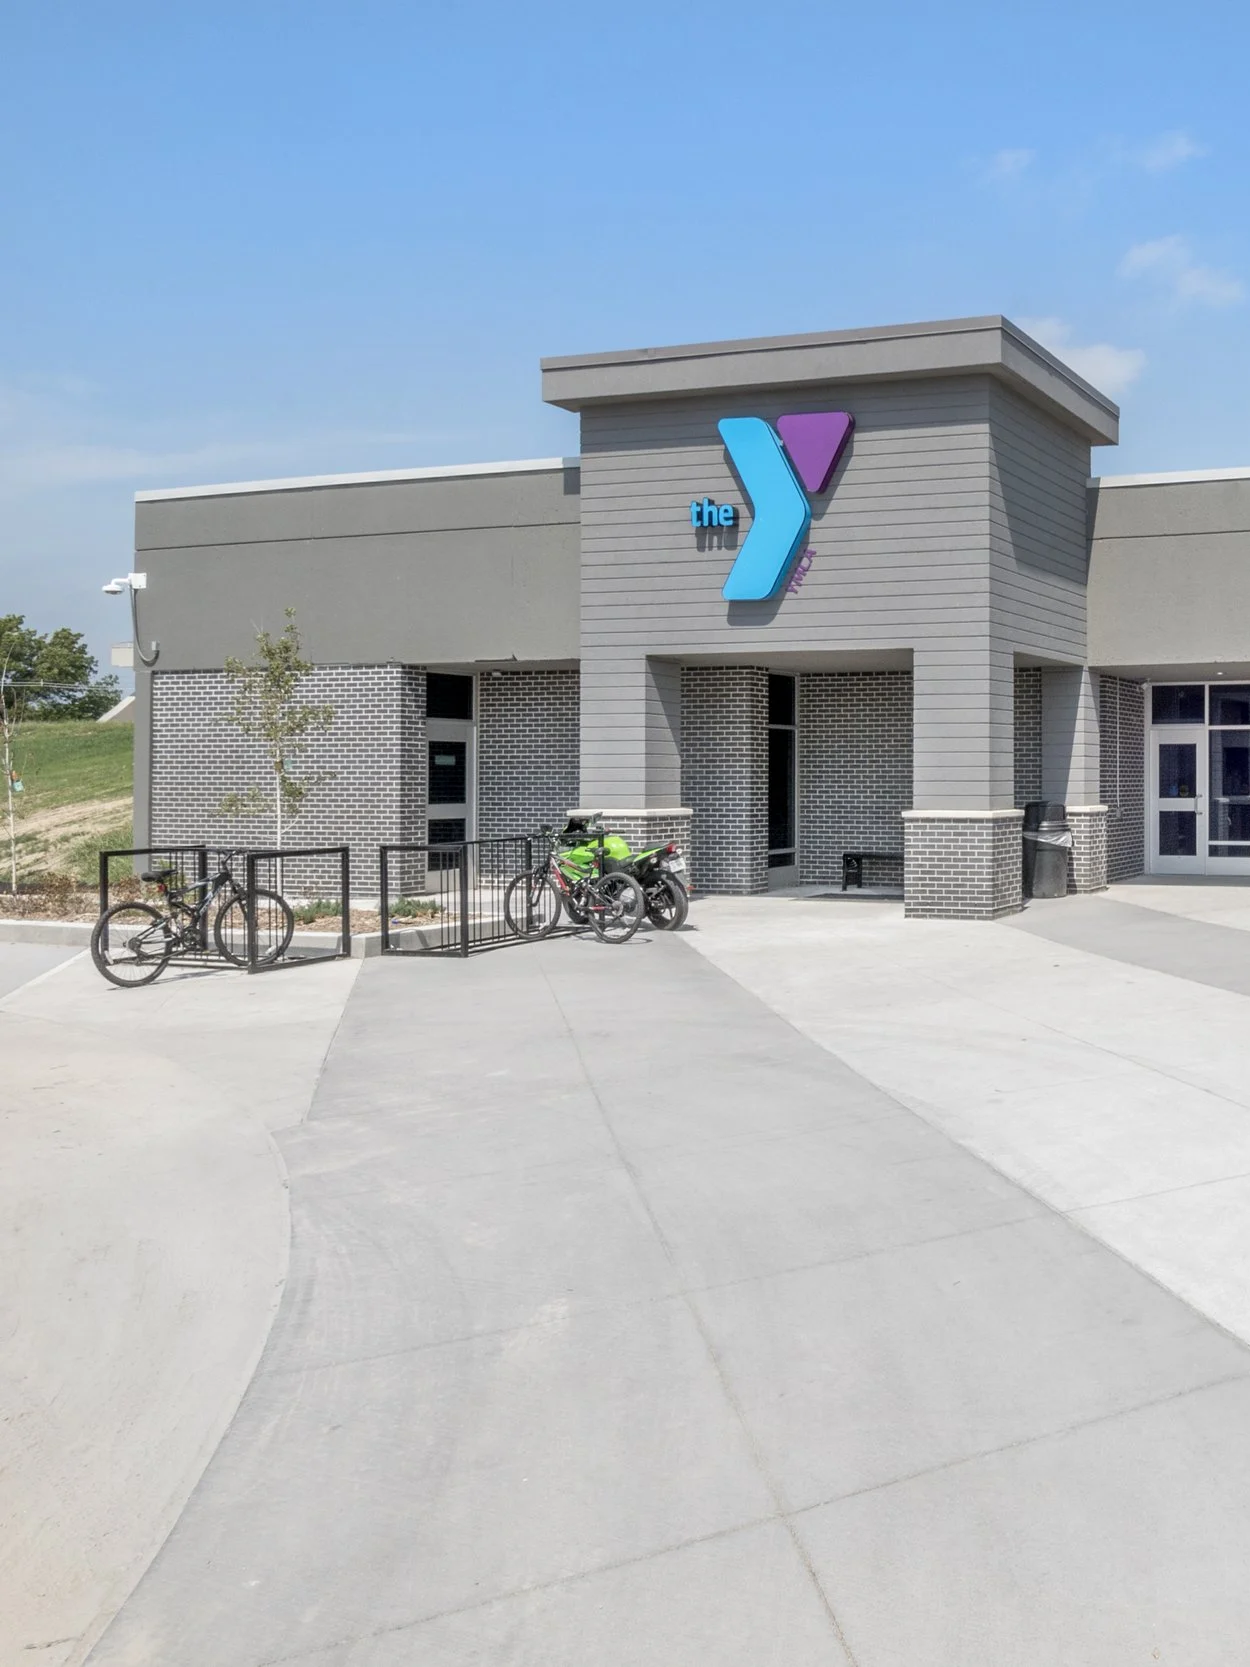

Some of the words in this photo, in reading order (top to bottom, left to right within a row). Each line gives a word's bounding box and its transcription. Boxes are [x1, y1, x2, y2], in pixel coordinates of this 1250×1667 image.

[690, 496, 734, 527] the
[717, 411, 856, 601] Y
[785, 548, 817, 595] YMCA
